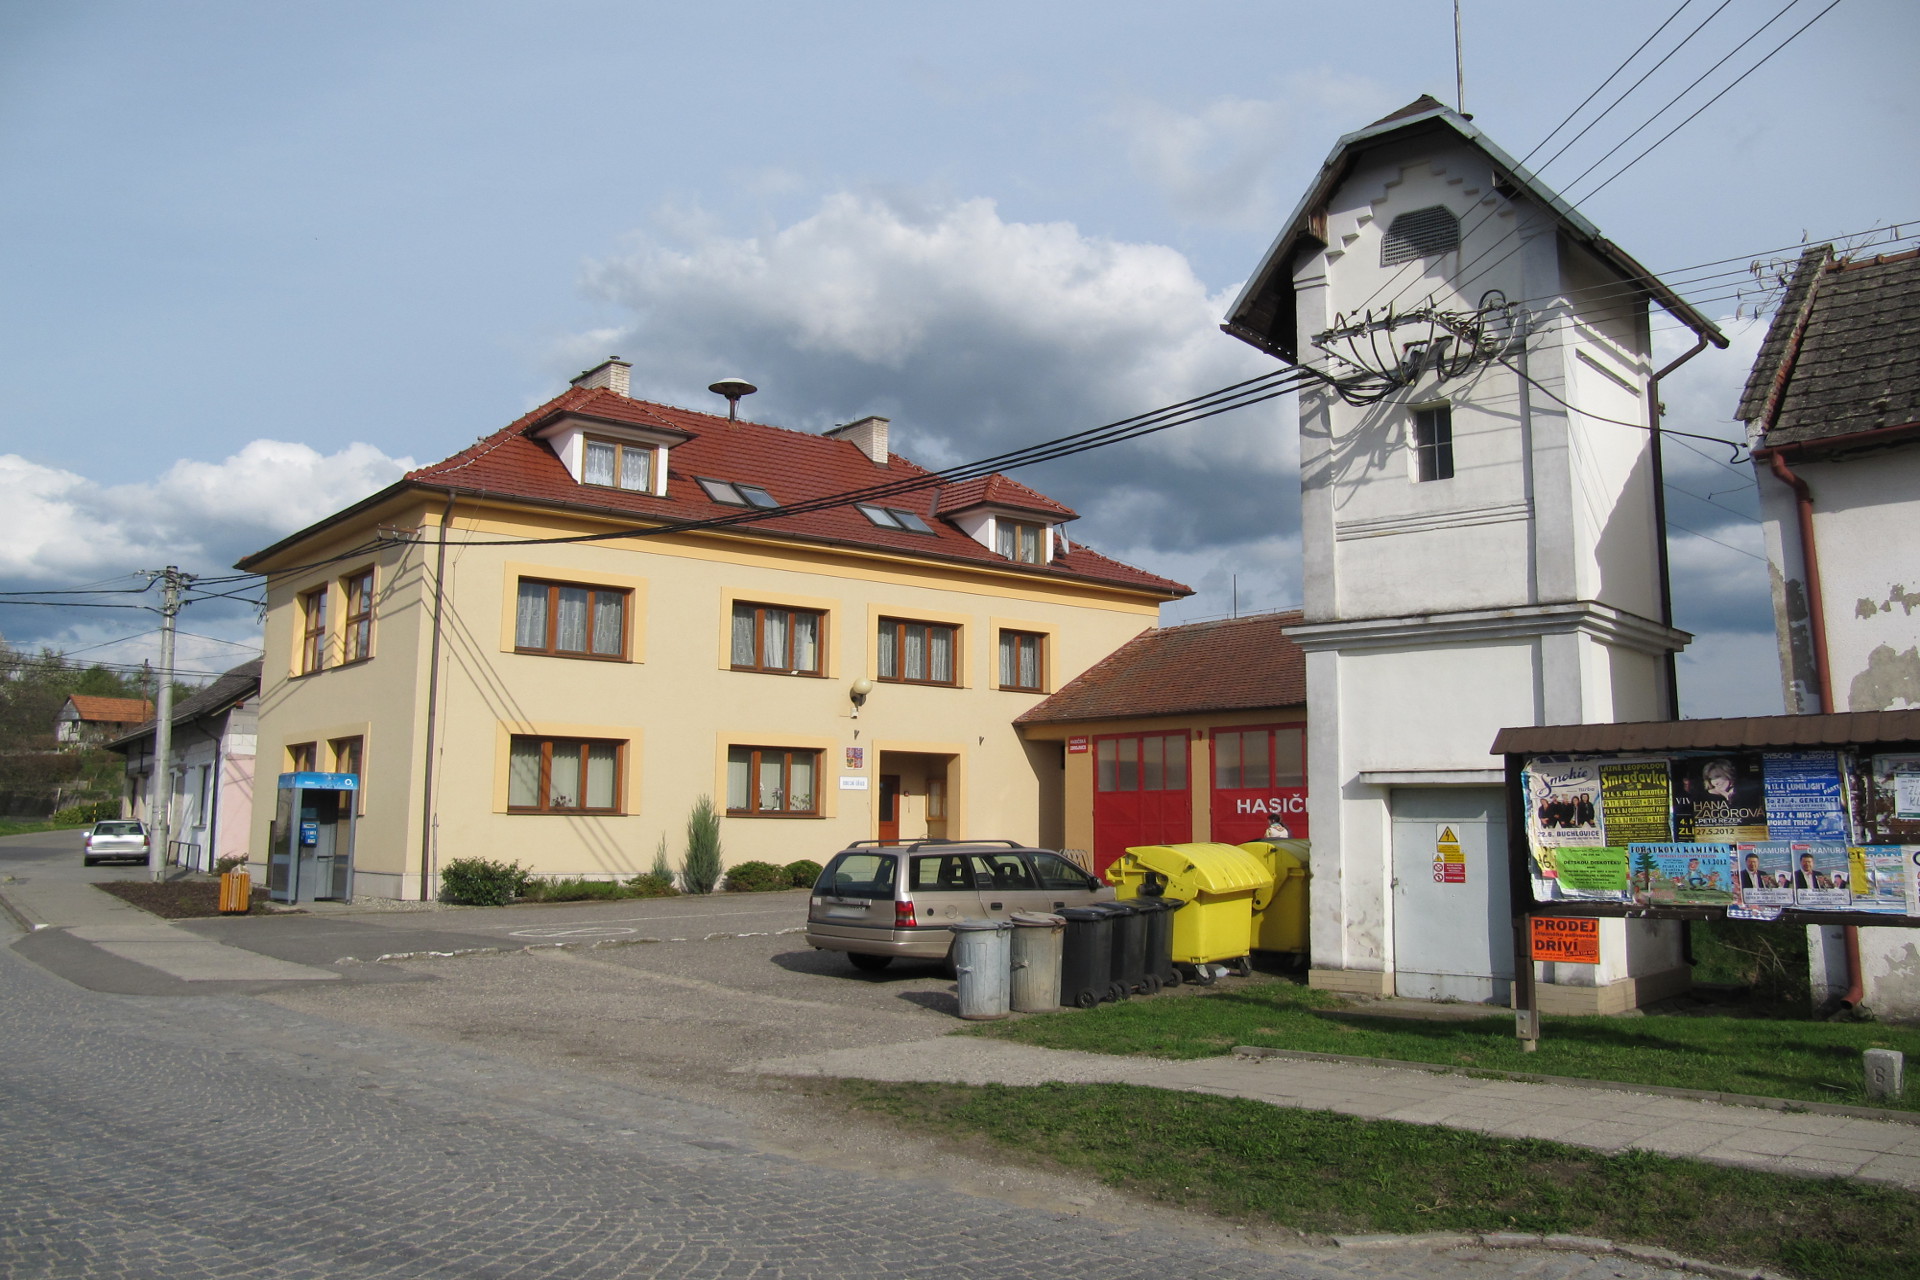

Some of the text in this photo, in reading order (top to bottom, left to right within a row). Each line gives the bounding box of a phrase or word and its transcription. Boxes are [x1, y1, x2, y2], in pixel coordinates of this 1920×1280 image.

[1693, 801, 1729, 811] HANA
[1752, 846, 1790, 854] OKAMURA
[1807, 845, 1846, 854] OKAMURA
[1534, 920, 1596, 932] PRODEJ
[1535, 936, 1578, 952] DŘÍVÍ
